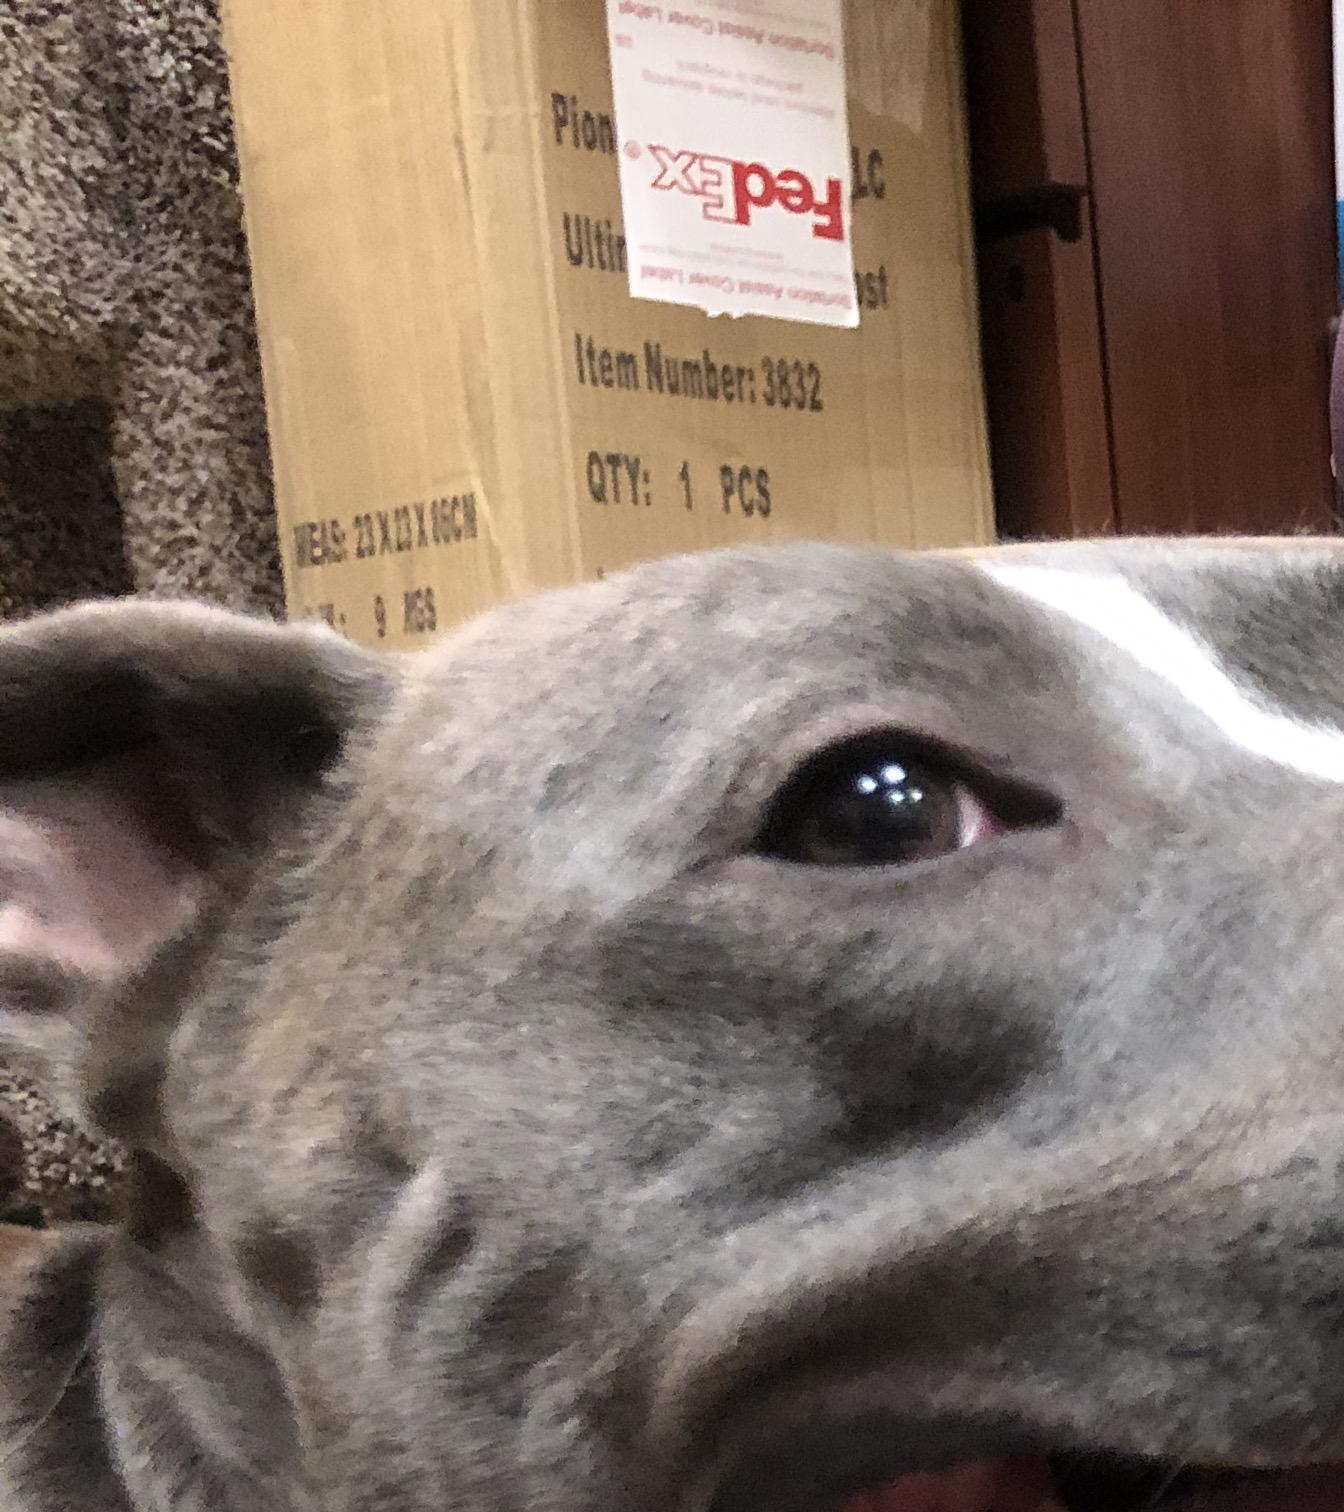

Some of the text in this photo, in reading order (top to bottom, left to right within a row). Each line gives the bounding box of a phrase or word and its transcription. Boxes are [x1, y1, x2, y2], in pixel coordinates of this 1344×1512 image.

[647, 143, 844, 241] FedEx
[575, 332, 824, 413] Item Number: 3832
[586, 450, 772, 518] QTY: 1 PCS
